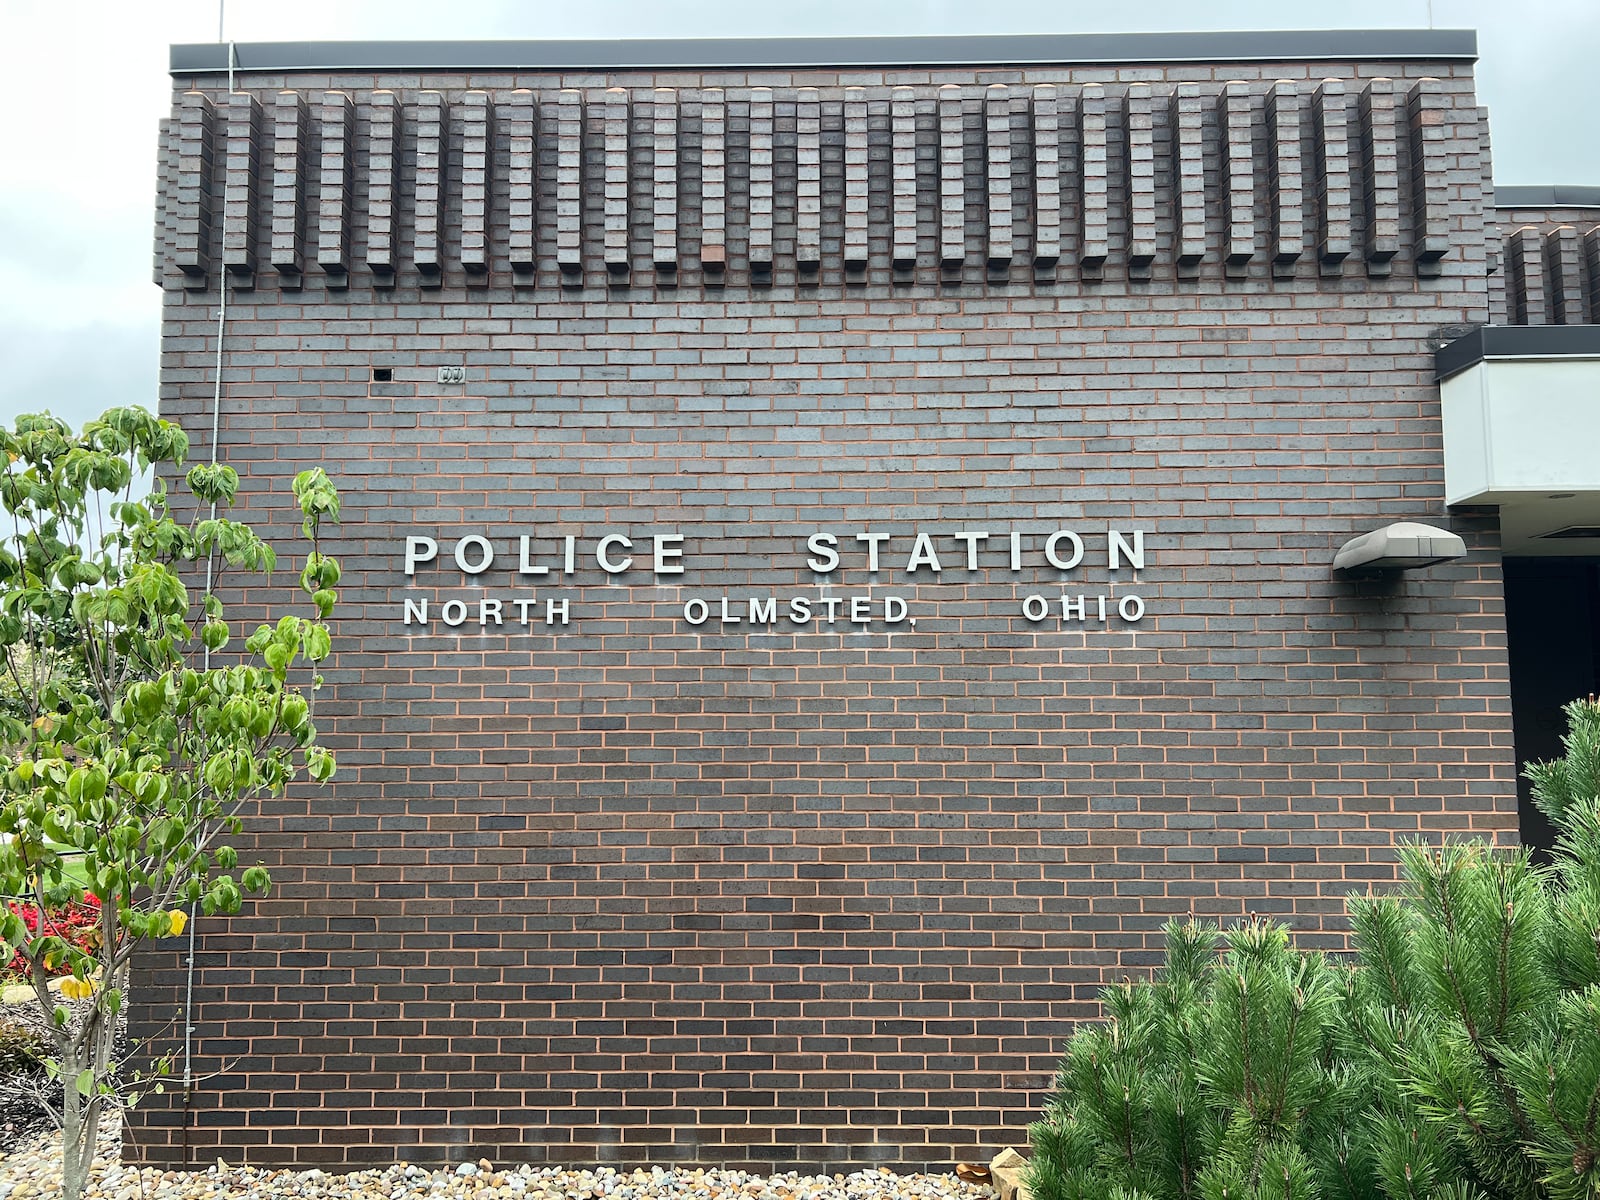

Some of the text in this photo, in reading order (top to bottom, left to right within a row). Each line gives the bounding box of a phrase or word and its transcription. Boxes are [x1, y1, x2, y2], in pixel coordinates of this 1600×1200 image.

[404, 529, 1146, 575] POLICE STATION
[403, 594, 1146, 627] NORTH OLMSTED, OHIO
